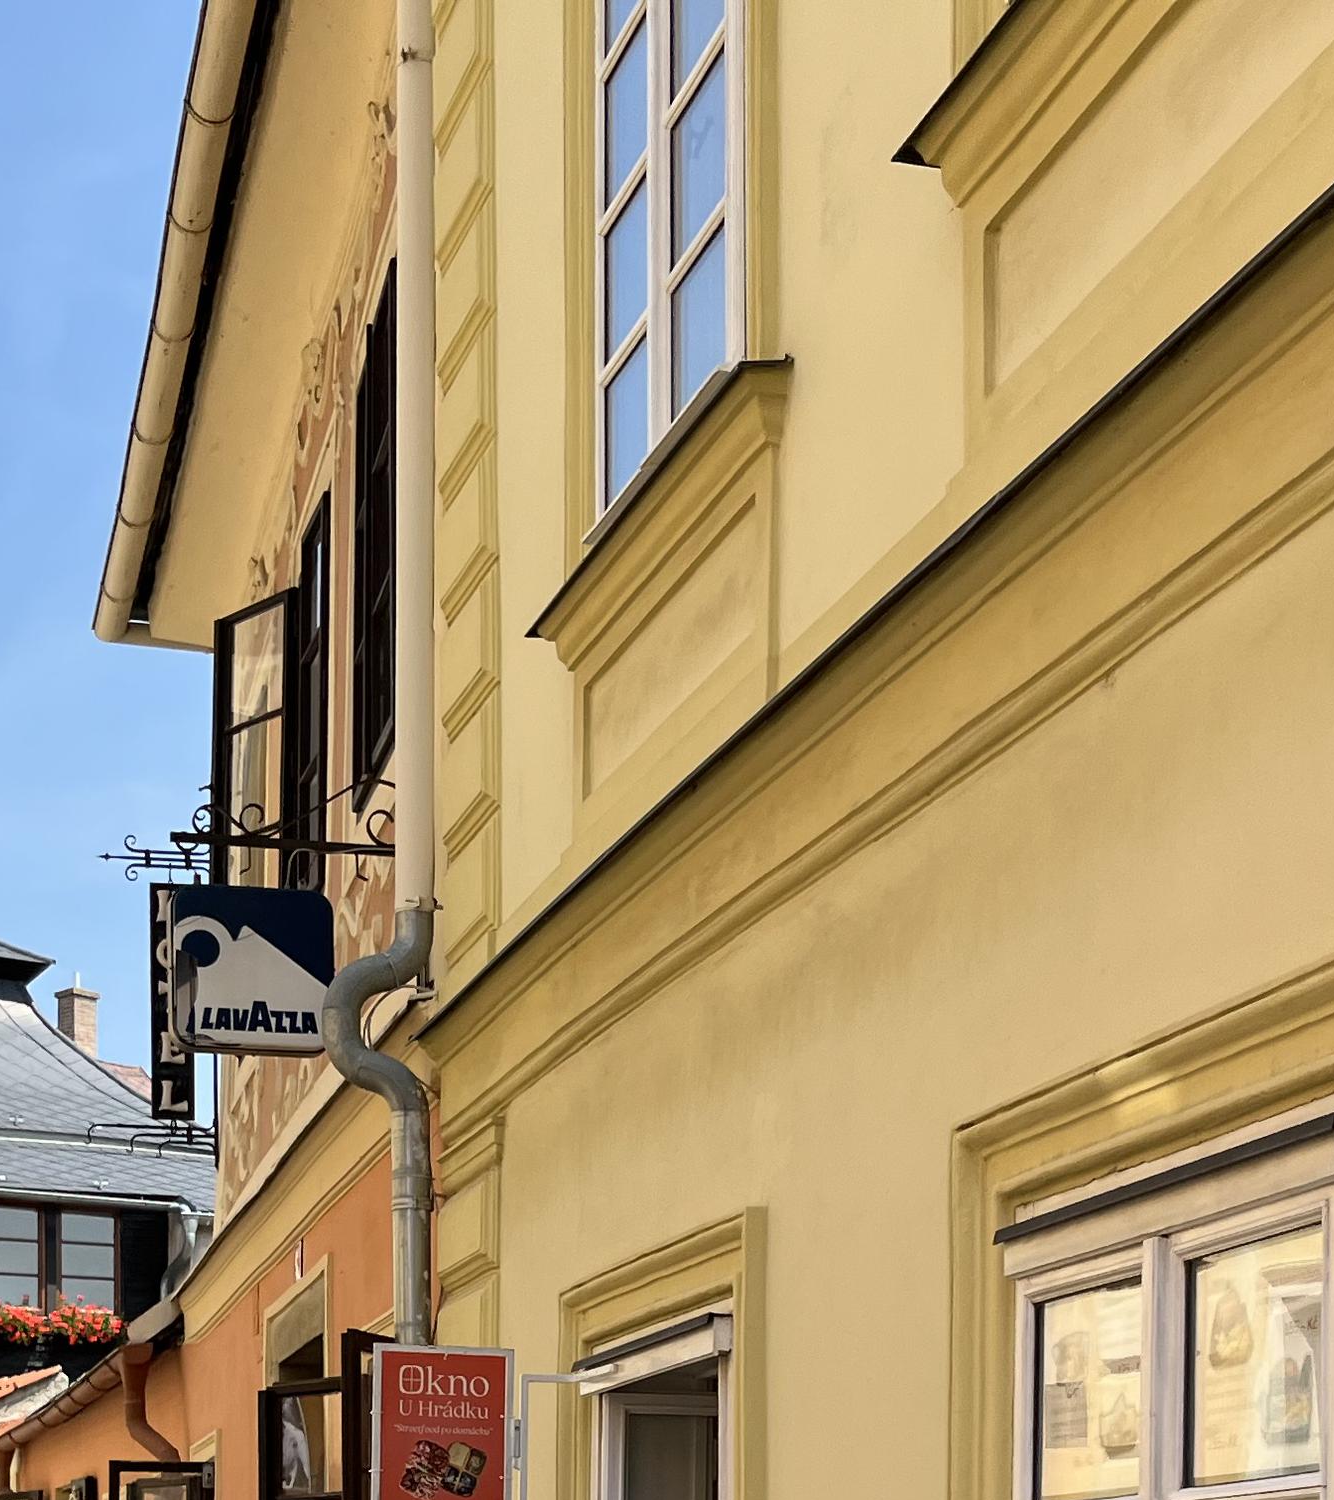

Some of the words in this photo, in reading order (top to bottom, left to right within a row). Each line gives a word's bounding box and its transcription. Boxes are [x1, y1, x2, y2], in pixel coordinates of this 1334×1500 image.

[200, 1001, 319, 1034] LAVAZZA
[399, 1364, 490, 1397] Okno
[399, 1400, 414, 1416] U
[419, 1400, 489, 1420] Hrádku
